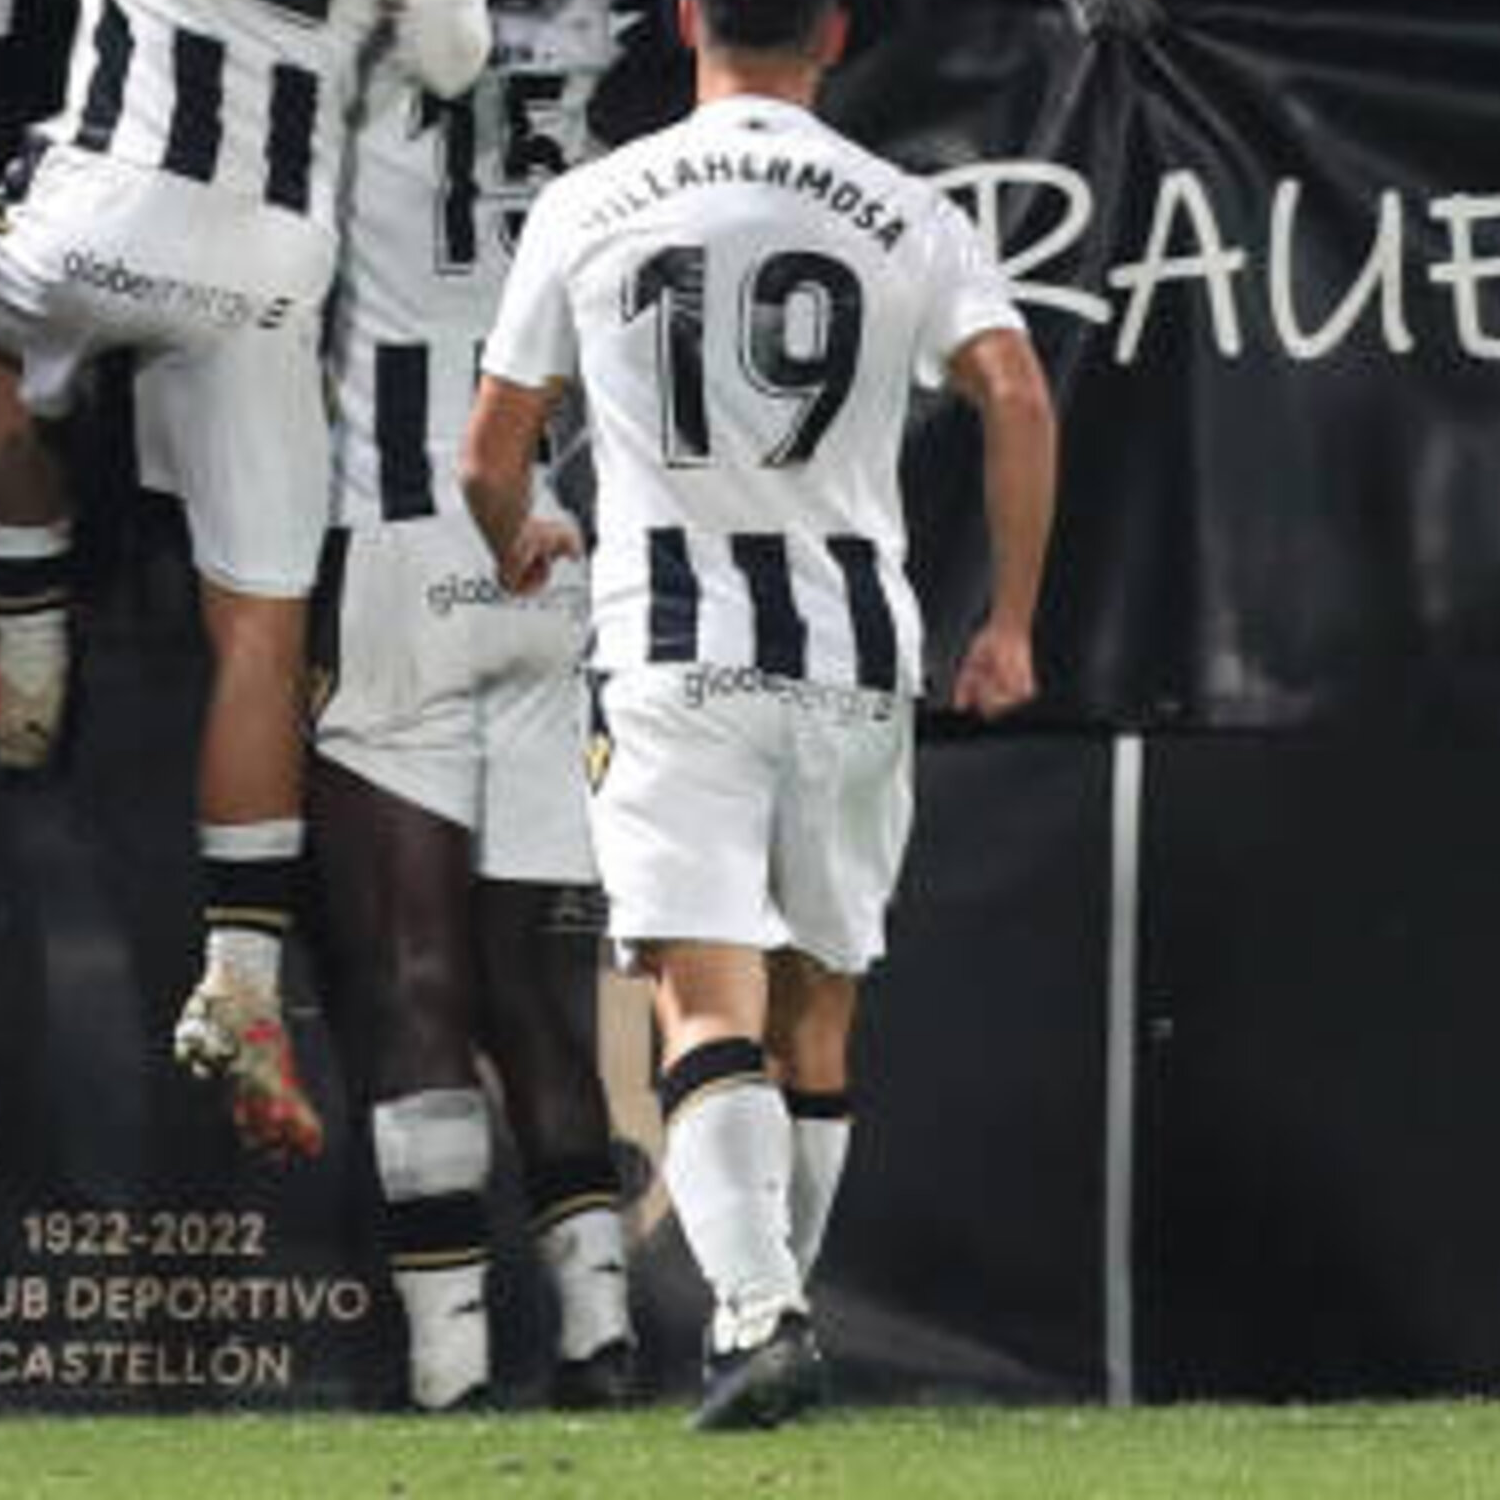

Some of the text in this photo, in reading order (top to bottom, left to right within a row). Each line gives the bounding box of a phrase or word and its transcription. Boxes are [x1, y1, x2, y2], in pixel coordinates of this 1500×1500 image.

[407, 70, 568, 277] 15
[580, 153, 906, 252] ILLAHERMOSA
[621, 244, 864, 469] 19
[23, 1212, 266, 1256] 1922-2022
[65, 1280, 369, 1323] DEPORTIVO
